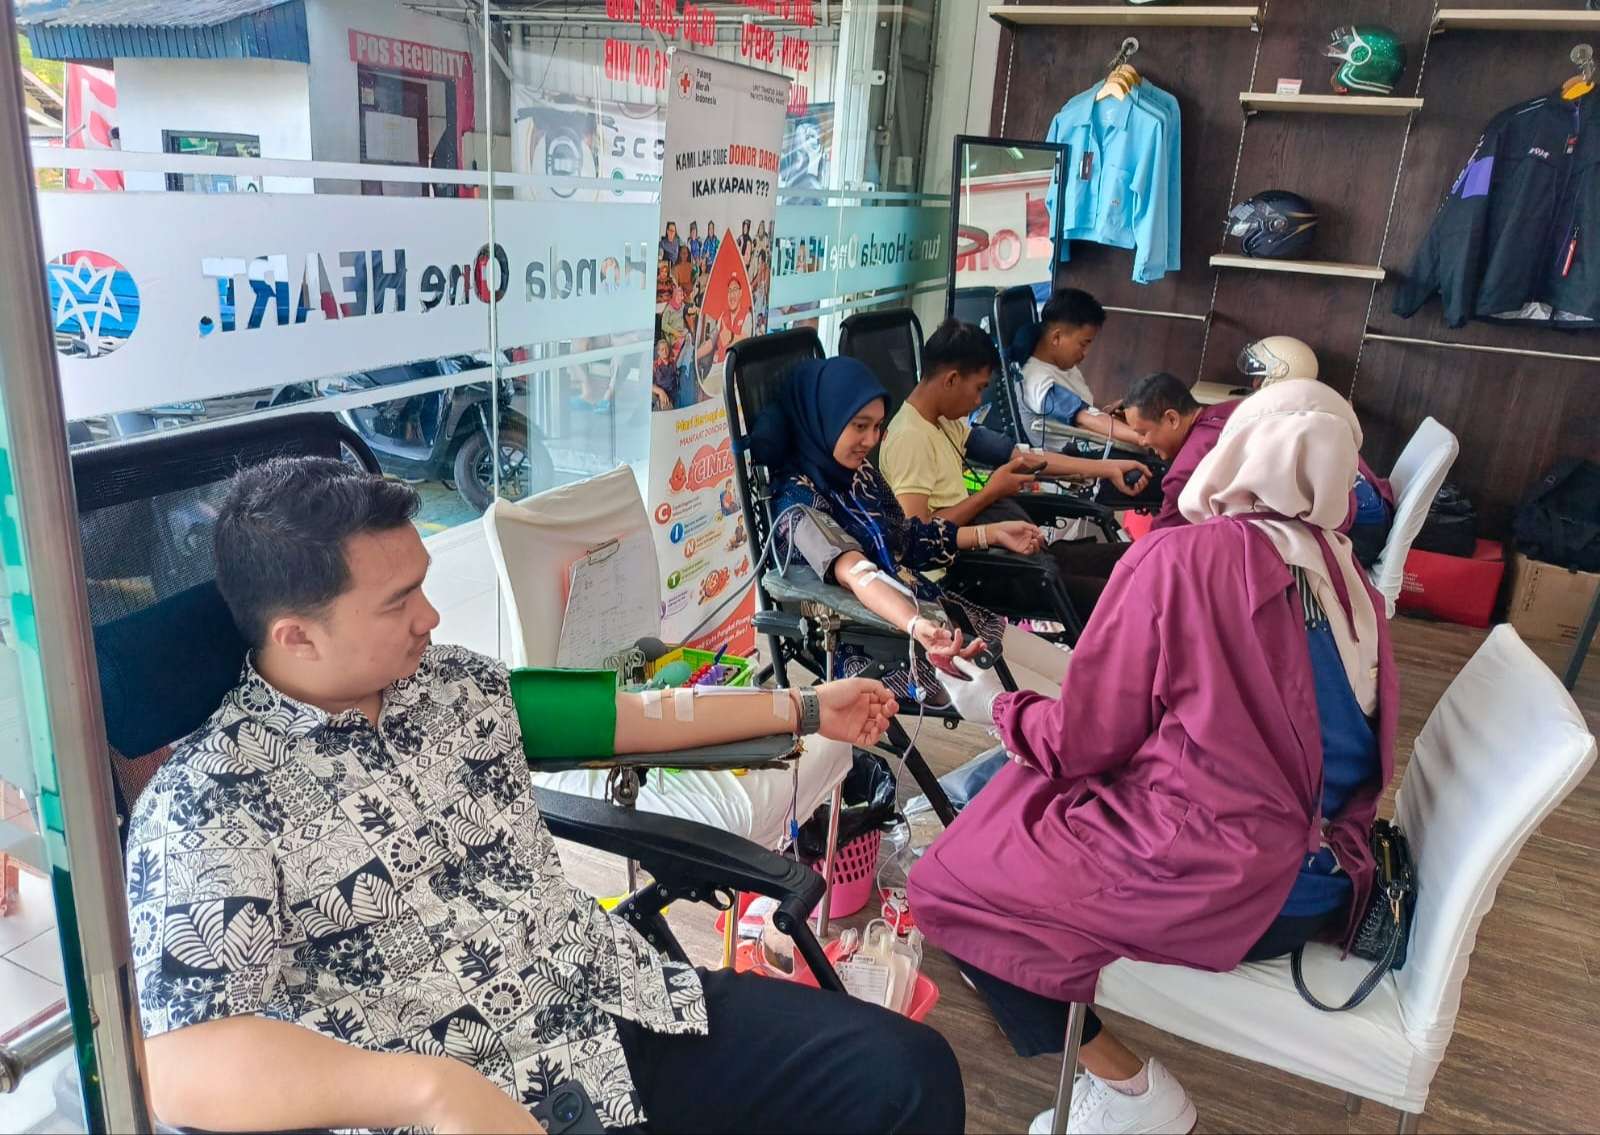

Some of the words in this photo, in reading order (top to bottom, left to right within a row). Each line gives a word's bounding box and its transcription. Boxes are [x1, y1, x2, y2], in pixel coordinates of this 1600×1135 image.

[356, 33, 390, 66] POS
[393, 42, 465, 79] SECURITY
[675, 151, 697, 171] KAMI
[697, 150, 711, 167] LAH
[728, 144, 757, 167] DONOR
[692, 179, 717, 198] IKAK
[718, 176, 754, 195] KAPAN
[755, 180, 770, 197] ???
